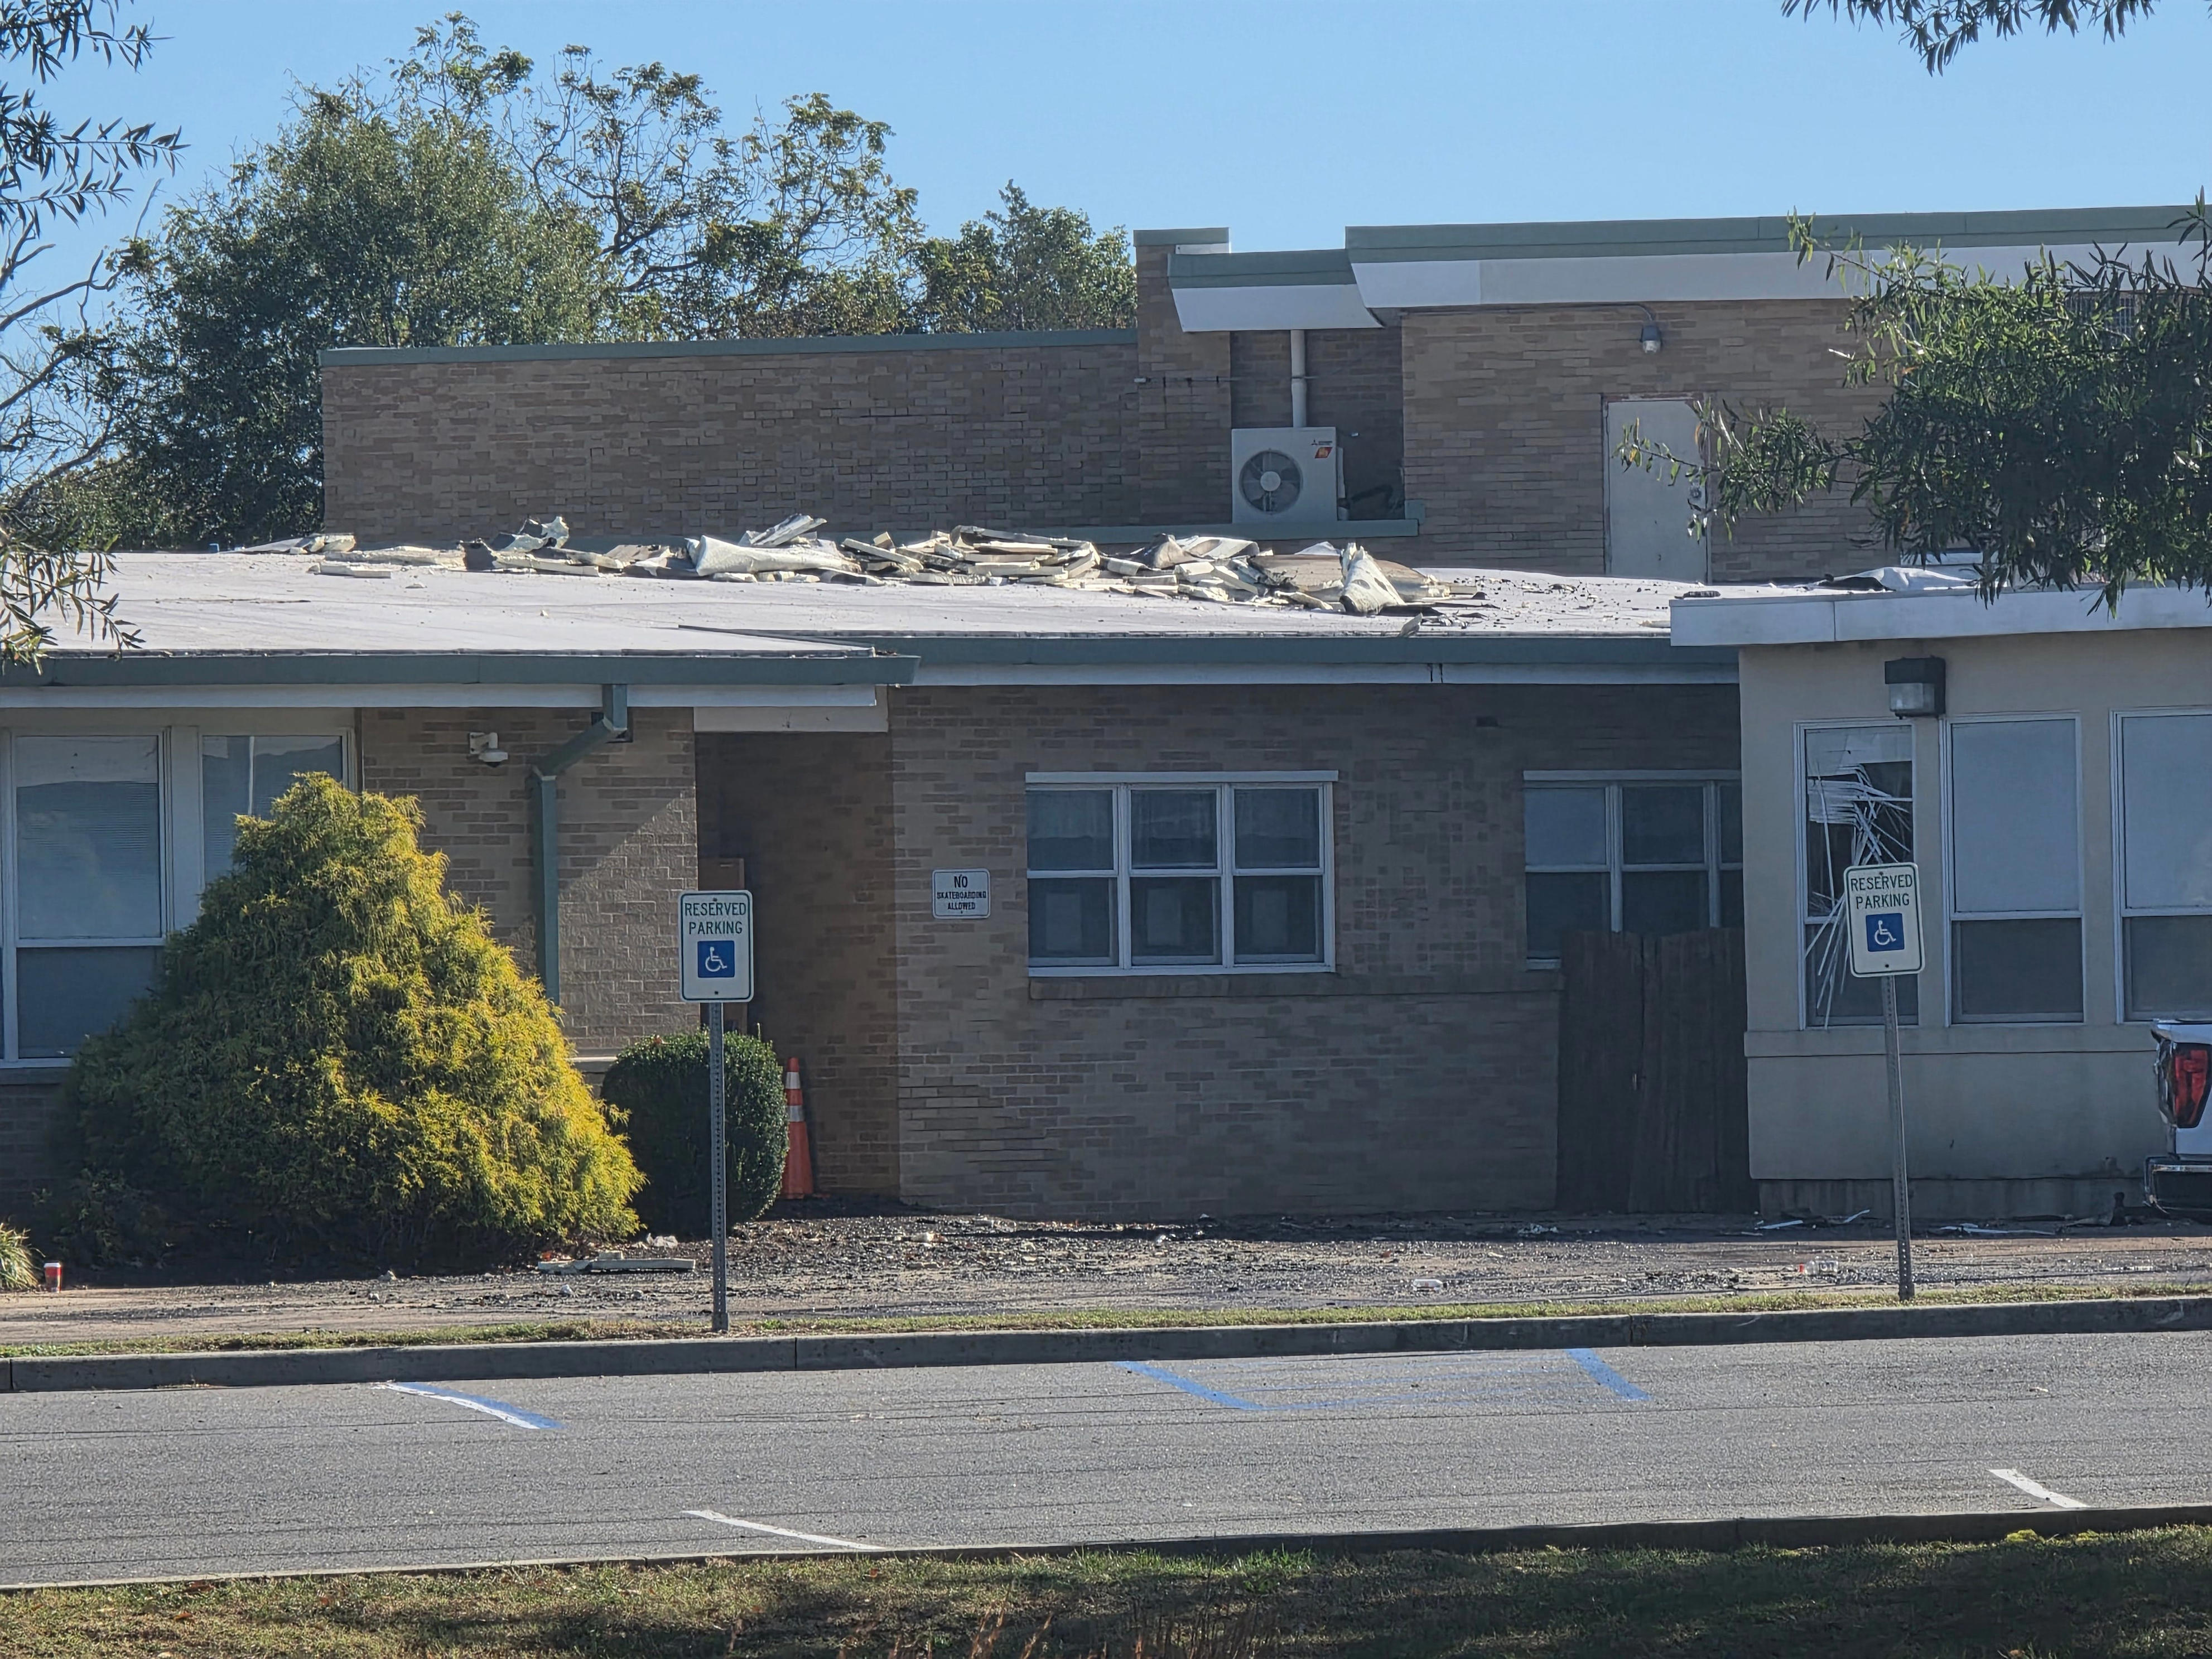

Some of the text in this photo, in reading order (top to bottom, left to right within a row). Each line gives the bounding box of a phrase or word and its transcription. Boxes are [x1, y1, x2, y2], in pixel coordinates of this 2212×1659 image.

[954, 875, 968, 888] NO
[1850, 874, 1913, 891] RESERVED
[1856, 893, 1910, 909] PARKING
[685, 903, 746, 916] RESERVED
[689, 921, 743, 935] PARKING
